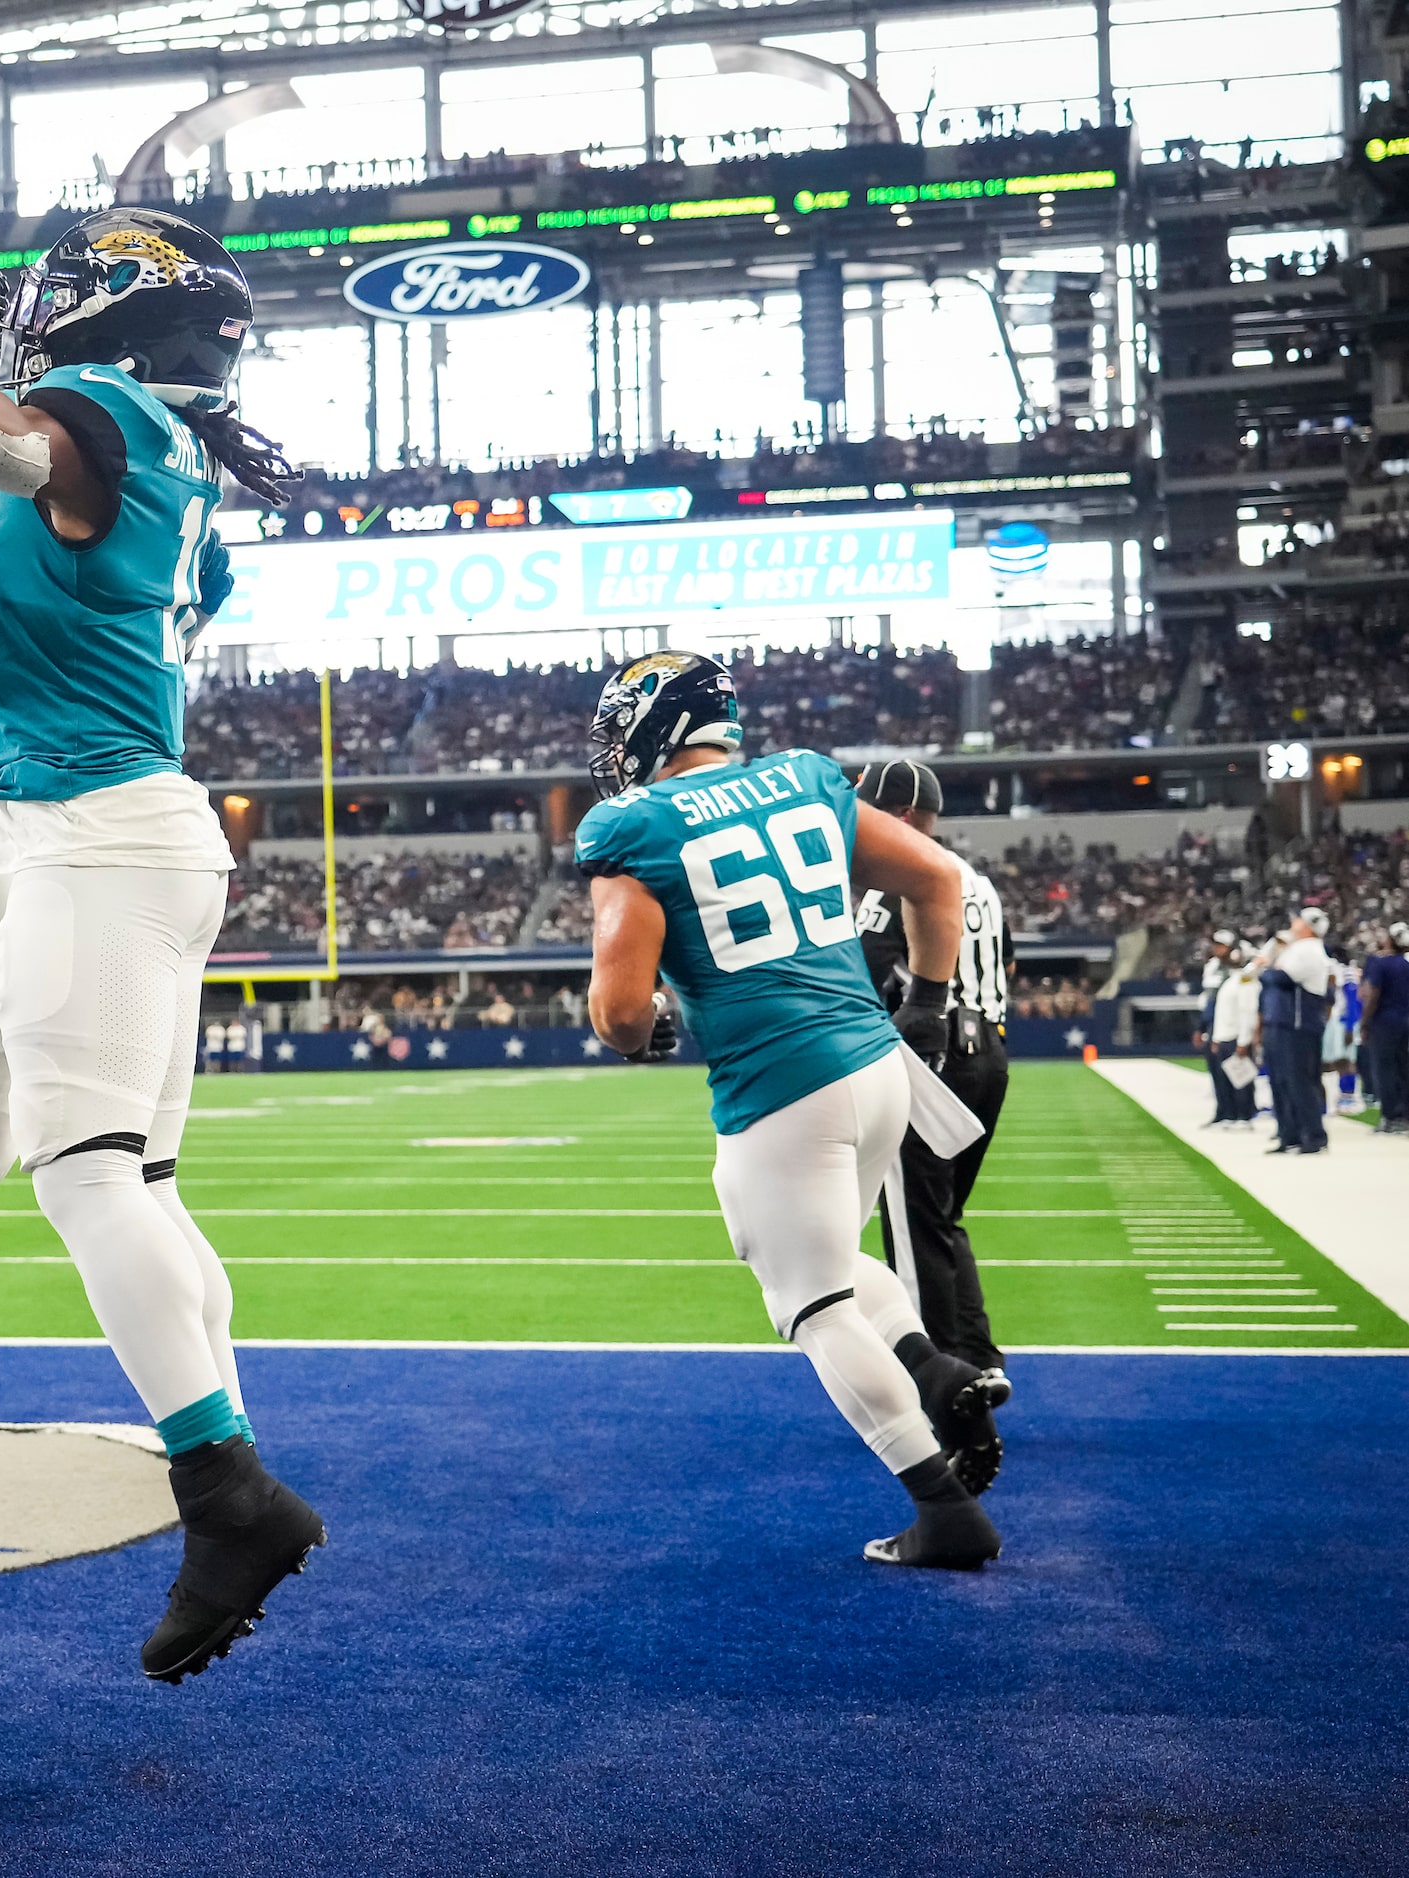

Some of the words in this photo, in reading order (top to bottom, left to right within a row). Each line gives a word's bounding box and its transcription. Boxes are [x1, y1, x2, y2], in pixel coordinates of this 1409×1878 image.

[391, 253, 541, 313] Ford
[604, 544, 679, 574] NOW
[697, 533, 859, 570] LOCATED
[878, 531, 917, 560] IN
[325, 550, 561, 618] PROS
[597, 573, 671, 608] EAST
[674, 571, 734, 604] AND
[743, 566, 819, 600] WEST
[825, 560, 935, 597] PLAZAS
[671, 762, 803, 827] SHATLEY
[679, 802, 857, 973] 69
